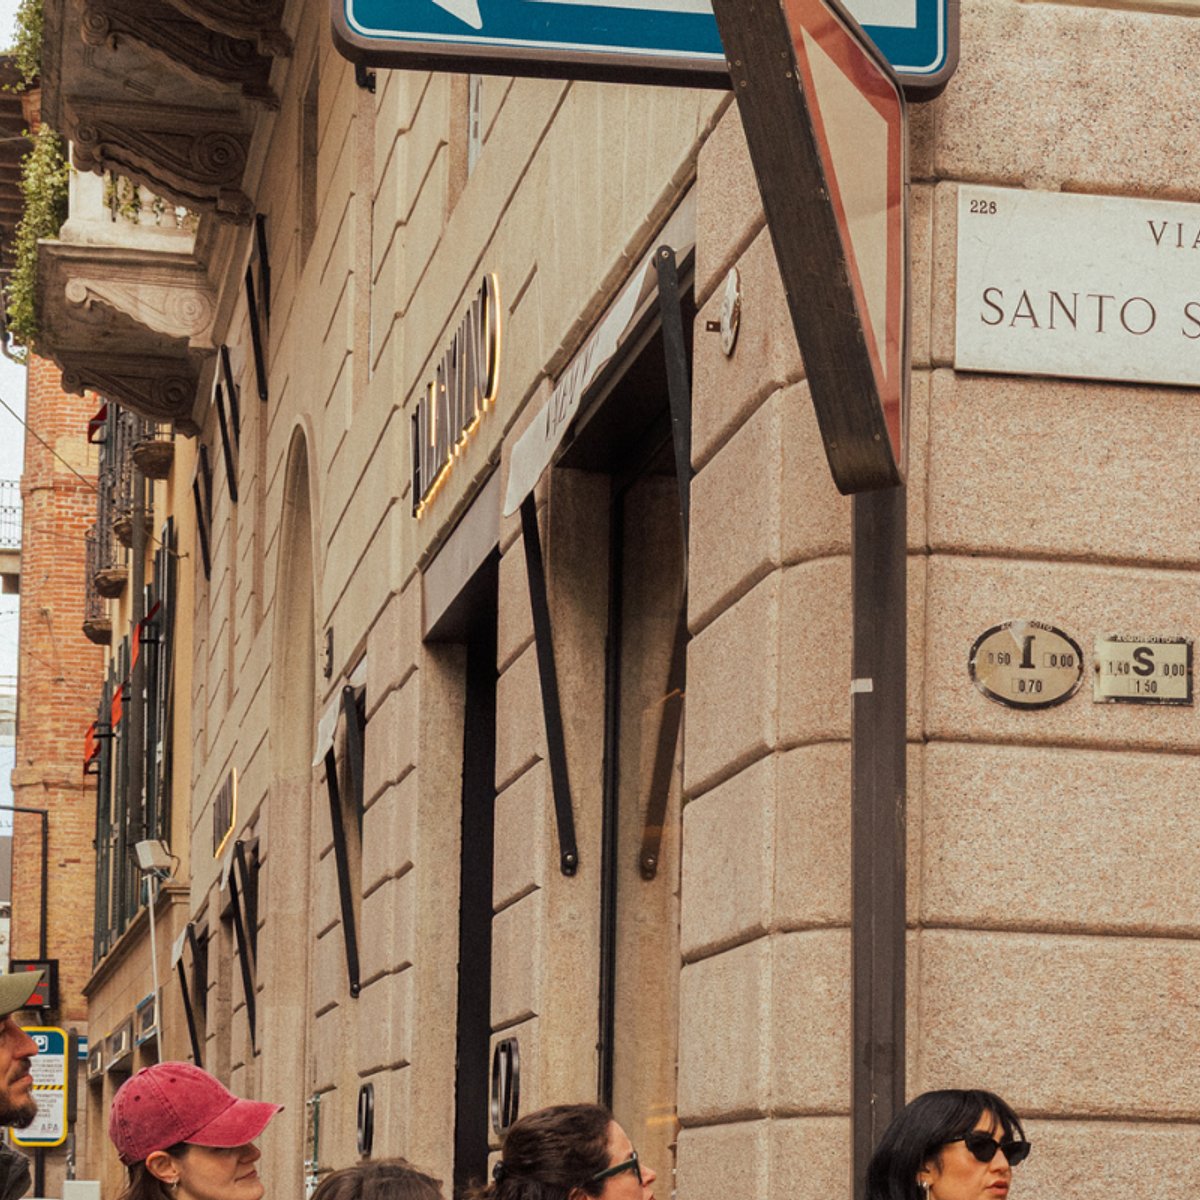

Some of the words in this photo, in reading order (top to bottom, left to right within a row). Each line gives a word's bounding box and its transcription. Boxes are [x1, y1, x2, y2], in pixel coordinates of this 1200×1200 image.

[969, 199, 998, 215] 228
[980, 286, 1157, 336] SANTO
[1132, 646, 1155, 677] S
